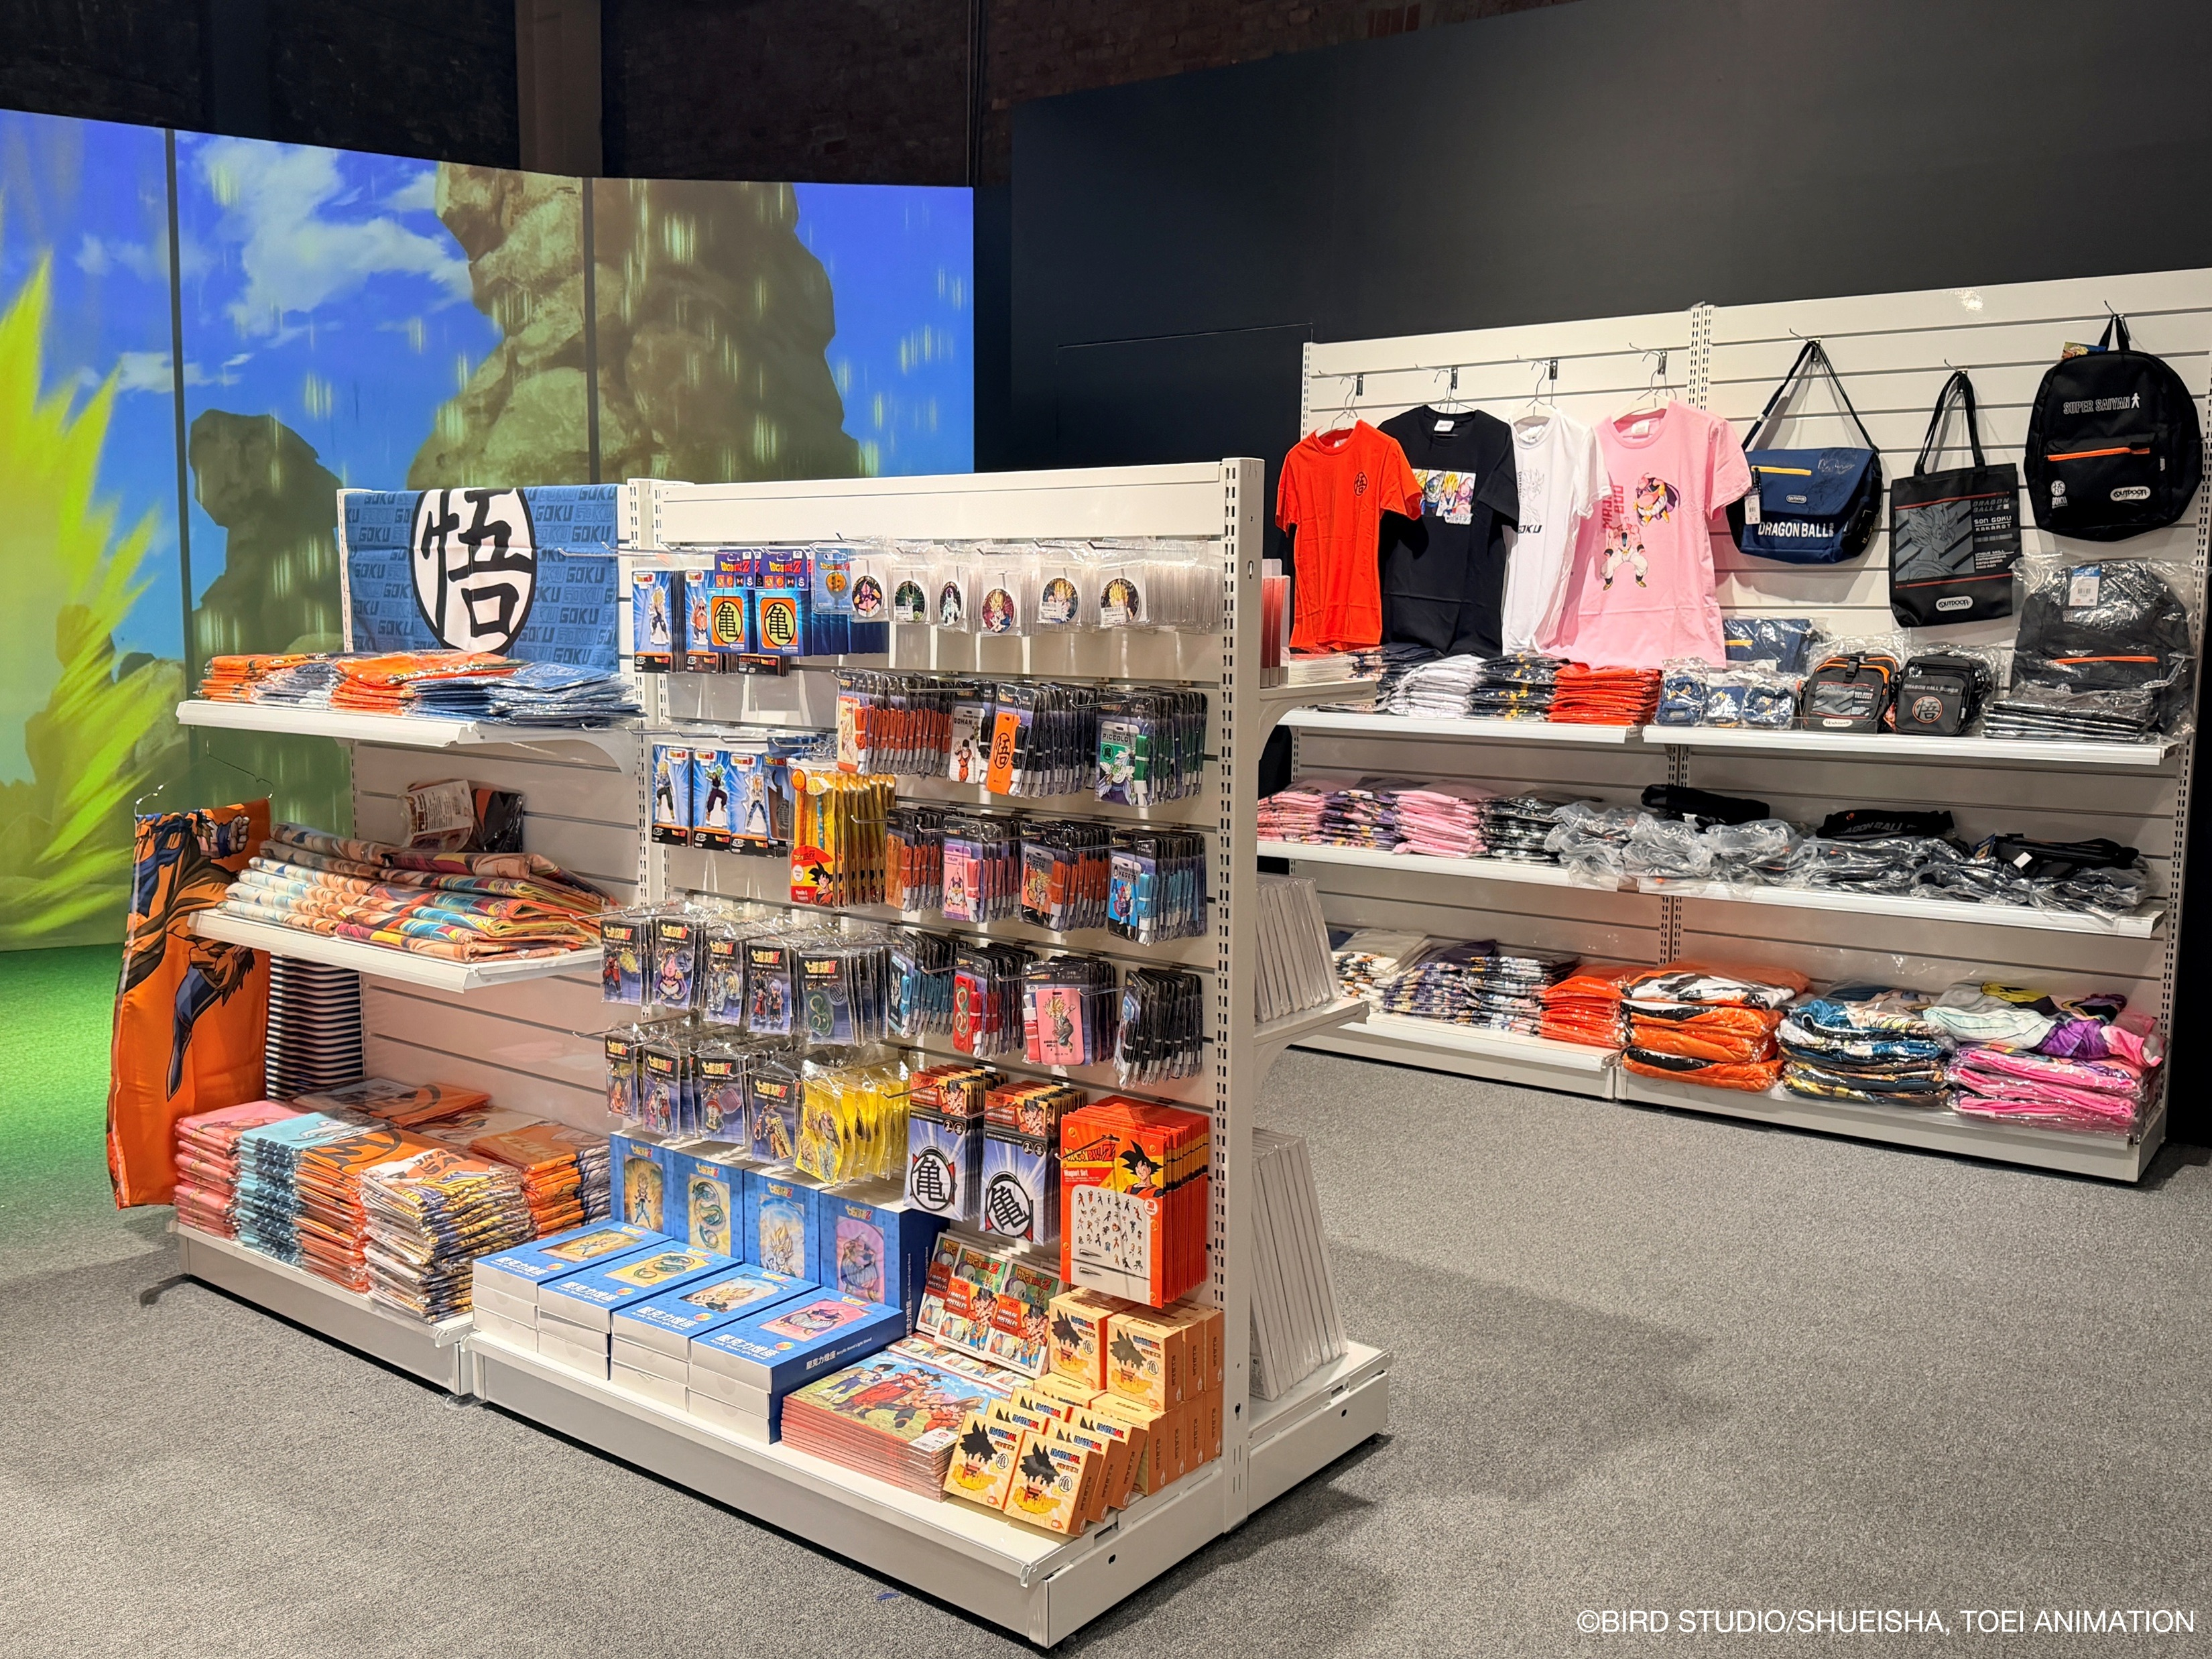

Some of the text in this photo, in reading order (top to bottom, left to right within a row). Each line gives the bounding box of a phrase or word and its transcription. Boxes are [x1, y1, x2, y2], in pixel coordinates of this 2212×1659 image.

[2063, 397, 2130, 414] SUPER SAIYAN
[1973, 498, 2010, 507] DRAGON
[537, 505, 574, 521] GOKU
[359, 527, 391, 542] GOKU
[572, 526, 611, 542] GOKU
[1976, 524, 2012, 532] KAKAROT
[355, 564, 386, 578] GOKU
[422, 488, 534, 648] 悟
[566, 567, 604, 583] GOKU
[560, 608, 599, 624] GOKU
[554, 648, 592, 664] GOKU
[1103, 733, 1129, 743] PICCOLO
